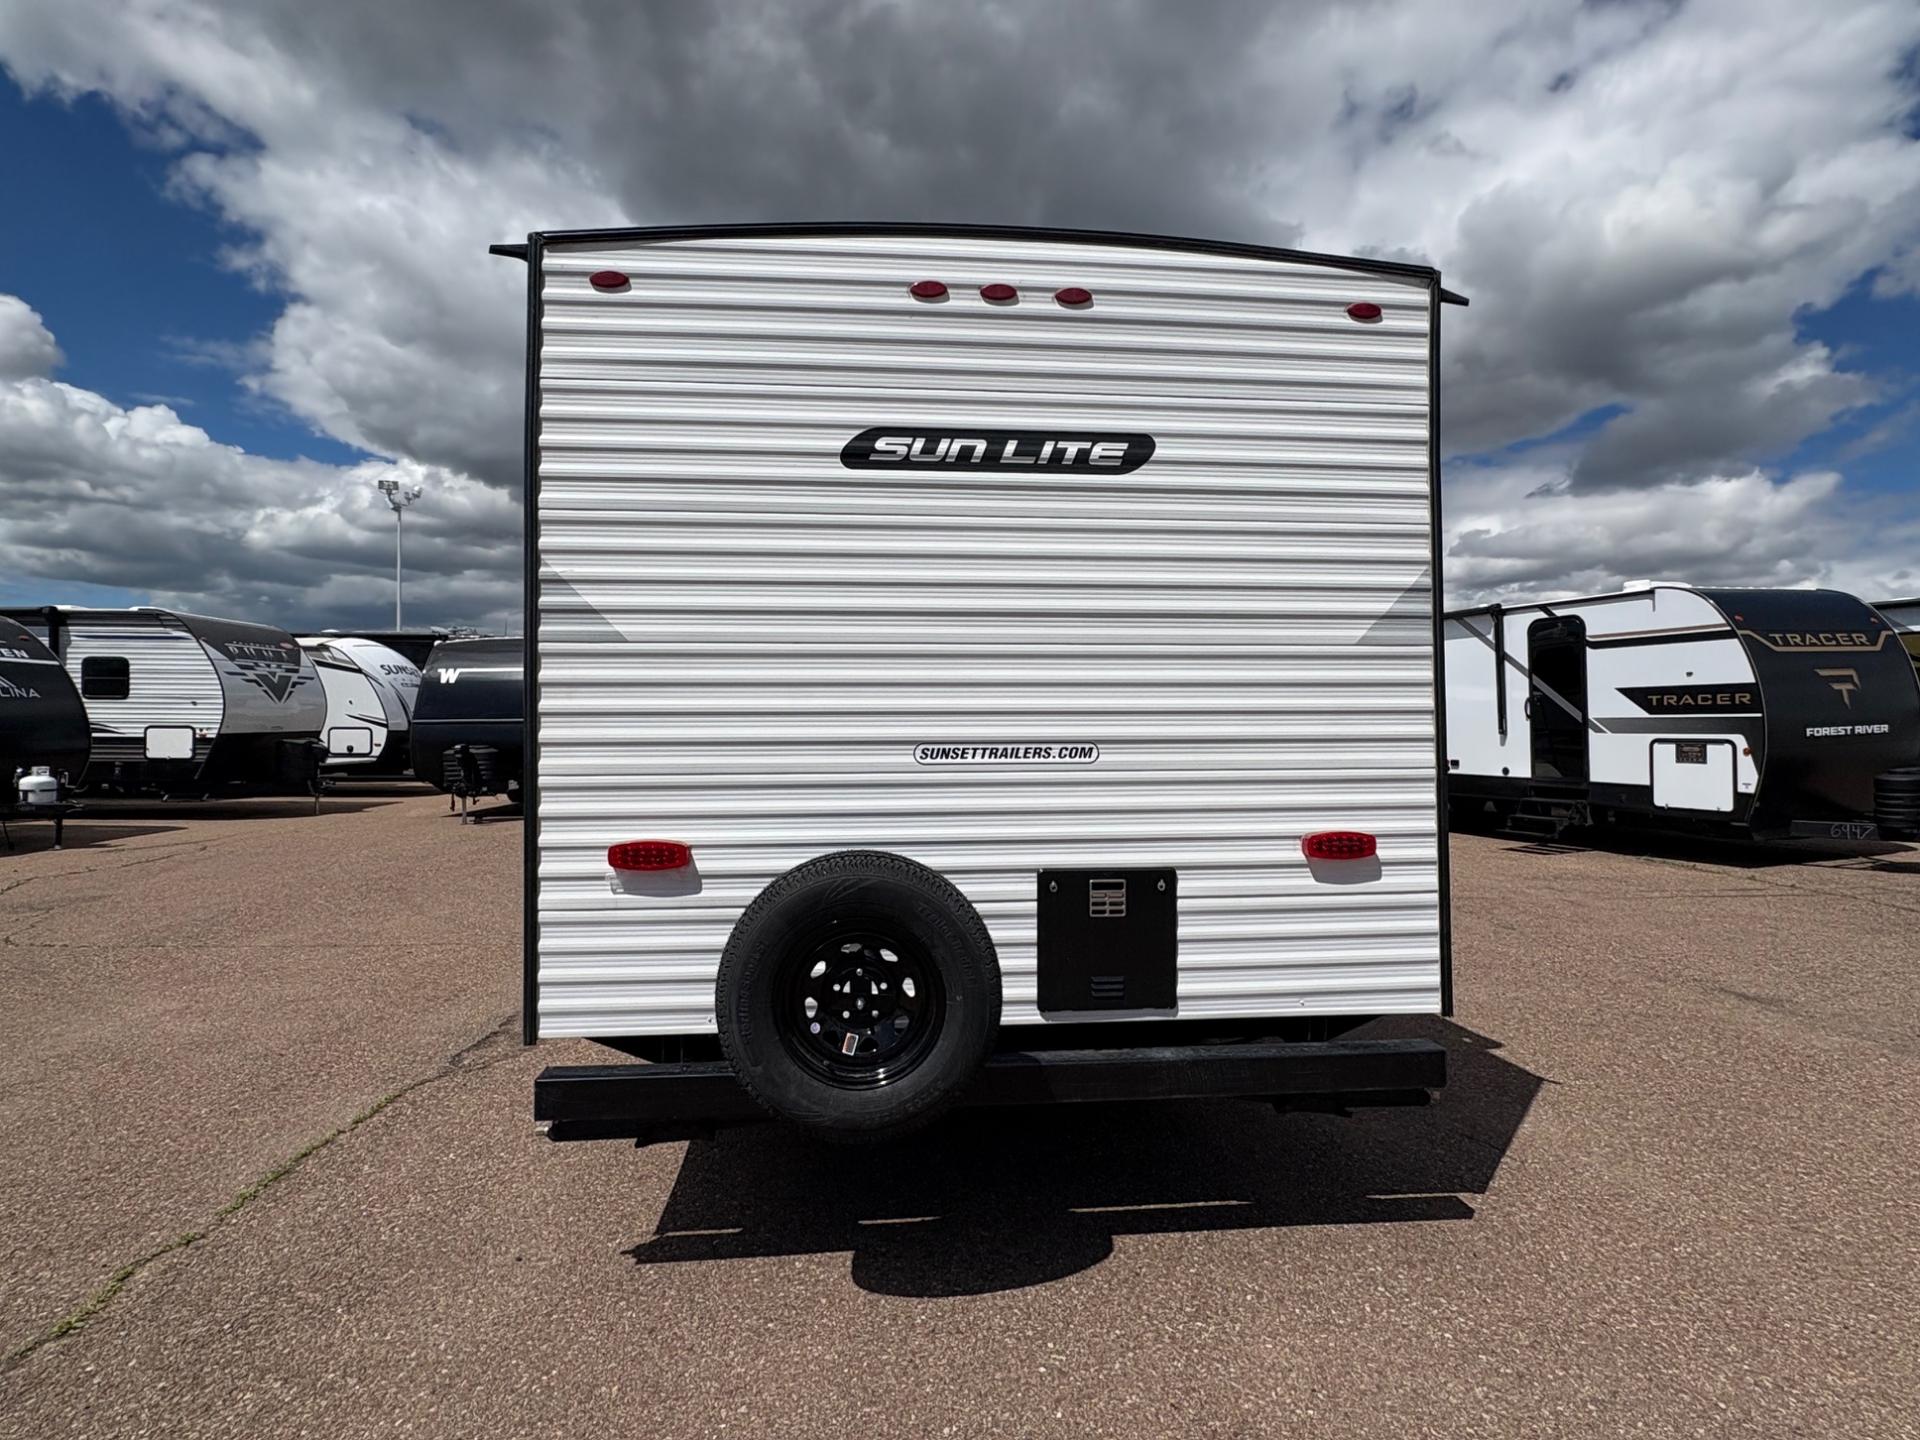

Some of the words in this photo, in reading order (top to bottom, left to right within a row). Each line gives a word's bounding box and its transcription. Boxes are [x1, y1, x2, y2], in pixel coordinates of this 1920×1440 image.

[869, 436, 988, 463] SUN
[1000, 439, 1129, 466] LITE
[1768, 633, 1871, 646] TRACER
[0, 647, 30, 658] EN
[1647, 693, 1752, 706] TRACER
[1806, 725, 1853, 737] FOREST
[1854, 724, 1889, 735] RIVER
[919, 746, 1094, 760] SUNSETTRAILERS.COM
